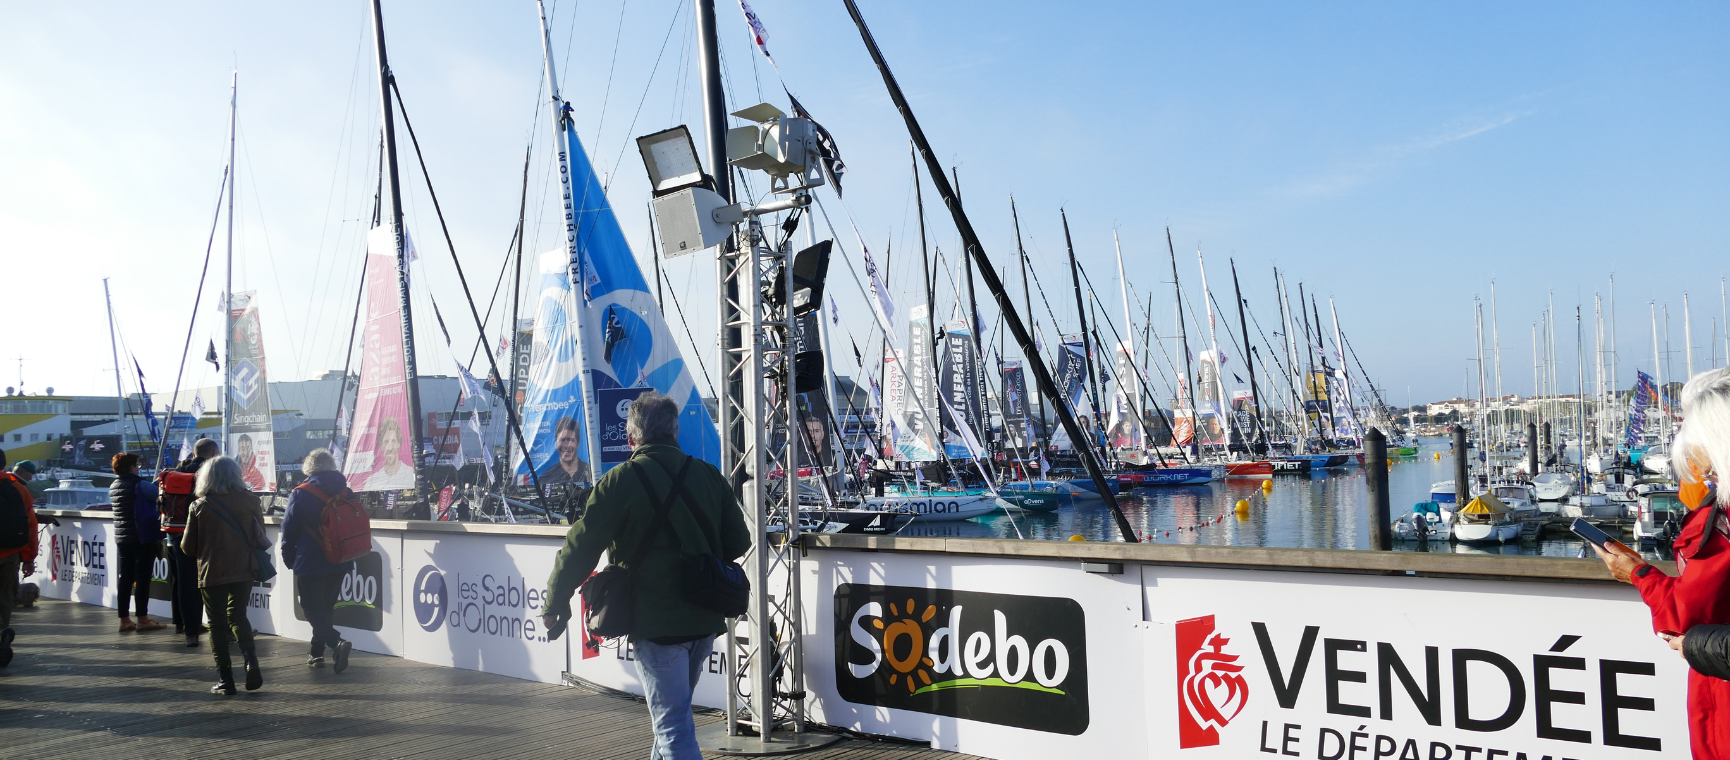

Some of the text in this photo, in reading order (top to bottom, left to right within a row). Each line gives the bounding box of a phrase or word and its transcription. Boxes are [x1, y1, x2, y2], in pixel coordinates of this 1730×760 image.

[558, 151, 580, 285] FRENCHBEE.COM
[396, 258, 405, 278] PAS
[398, 280, 408, 306] MAIS
[400, 309, 413, 362] SOLITAIRE
[405, 365, 414, 379] EN
[913, 327, 924, 431] VUNERABLE
[951, 338, 965, 430] ULNERABLE
[896, 374, 904, 416] PAPREC
[234, 413, 268, 427] Singchain
[605, 423, 617, 431] les
[60, 534, 105, 570] VENDÉE
[61, 569, 105, 586] LE DÉPARTEMENT
[457, 572, 479, 600] les
[847, 598, 1070, 690] Sodebo
[1250, 621, 1662, 752] VENDÉE
[1259, 719, 1301, 758] LE
